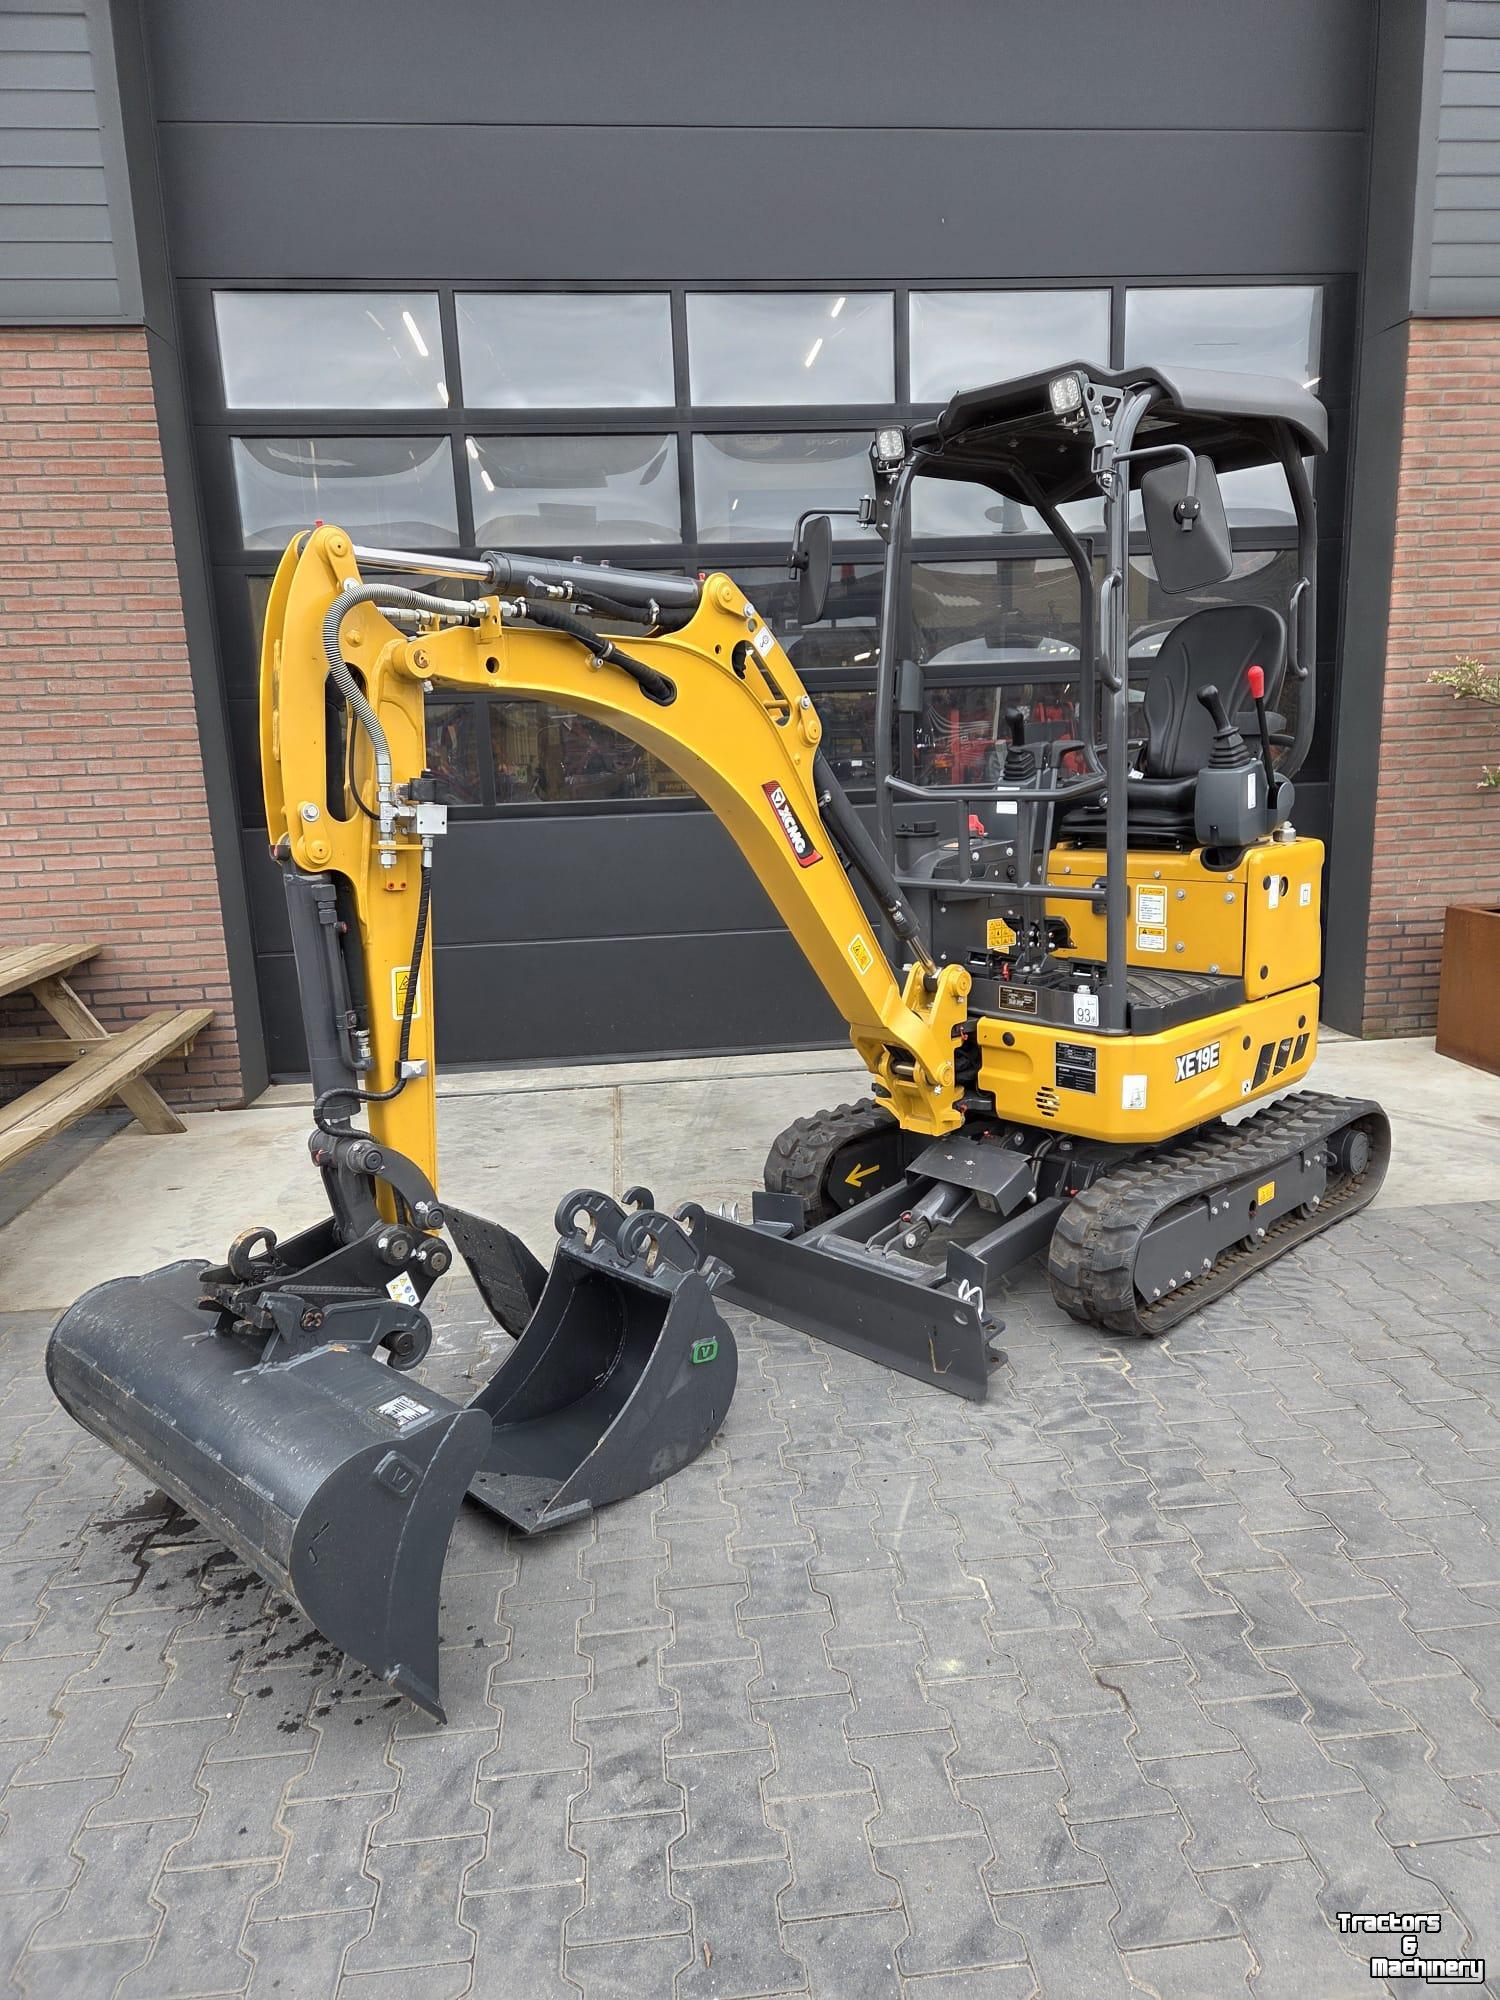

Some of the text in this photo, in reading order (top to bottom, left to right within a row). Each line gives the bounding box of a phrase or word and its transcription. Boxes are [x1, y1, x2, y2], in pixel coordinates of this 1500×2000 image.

[777, 804, 806, 854] XCMG
[1077, 1007, 1091, 1023] 93
[1175, 1041, 1220, 1083] XE19E
